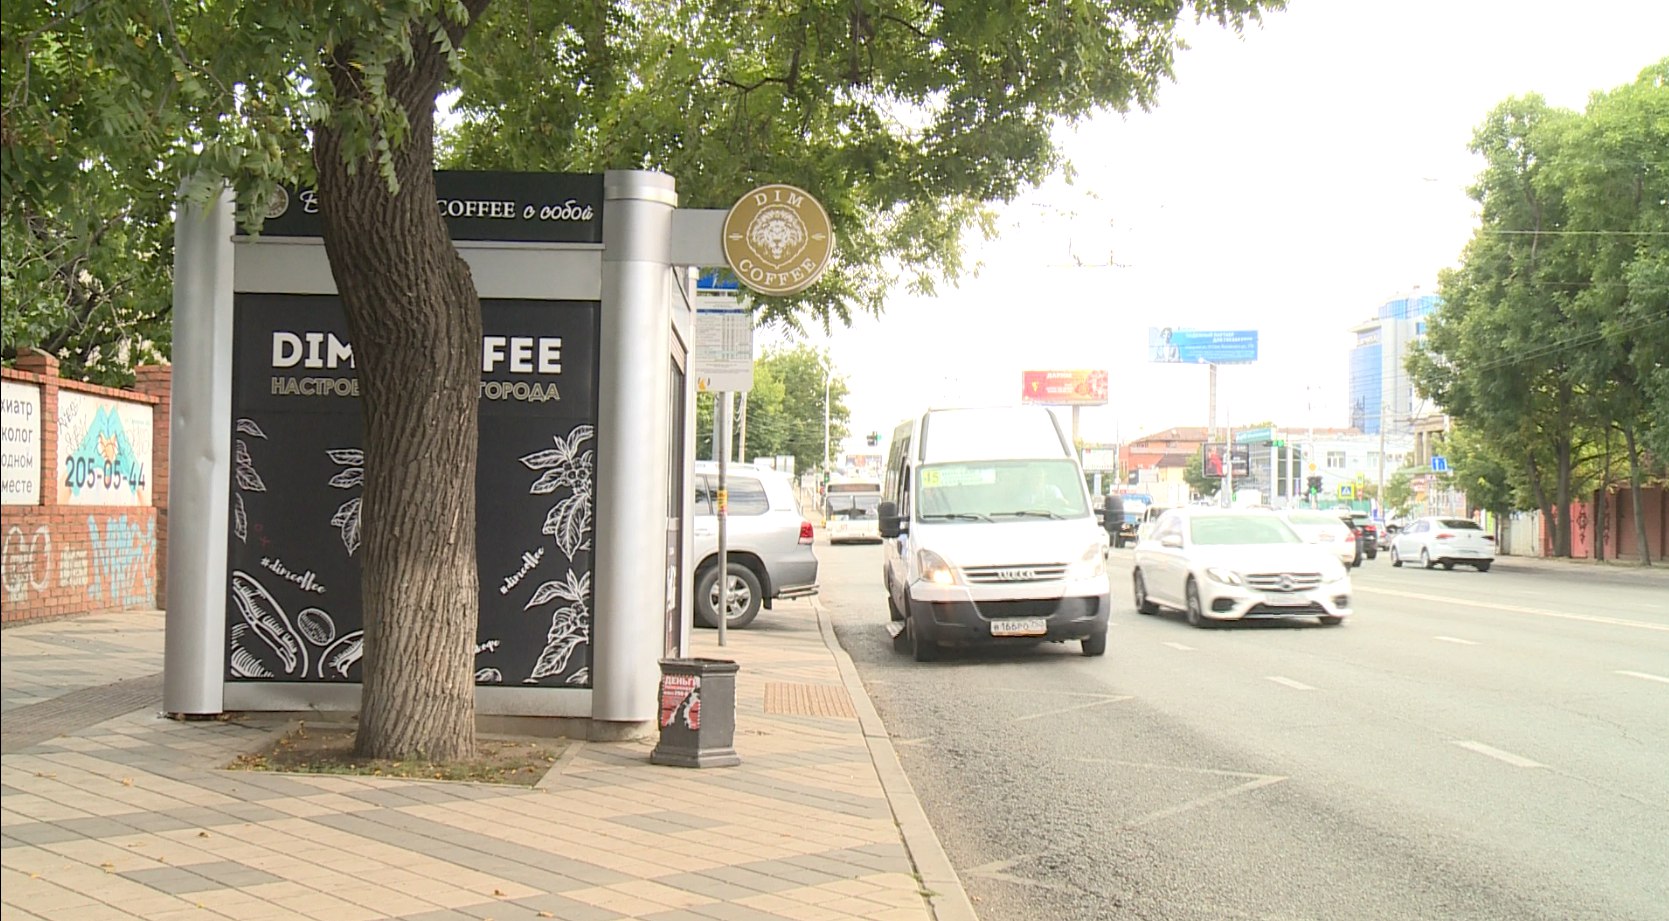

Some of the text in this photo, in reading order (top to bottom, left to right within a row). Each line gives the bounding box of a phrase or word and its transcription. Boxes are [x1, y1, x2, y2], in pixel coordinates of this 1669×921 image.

[436, 199, 594, 220] COFFEE с собой
[754, 189, 804, 208] DIM
[739, 257, 816, 286] COFFEE
[272, 331, 562, 374] DIM FEE
[1, 453, 33, 468] одном
[65, 455, 146, 491] 205-05-44
